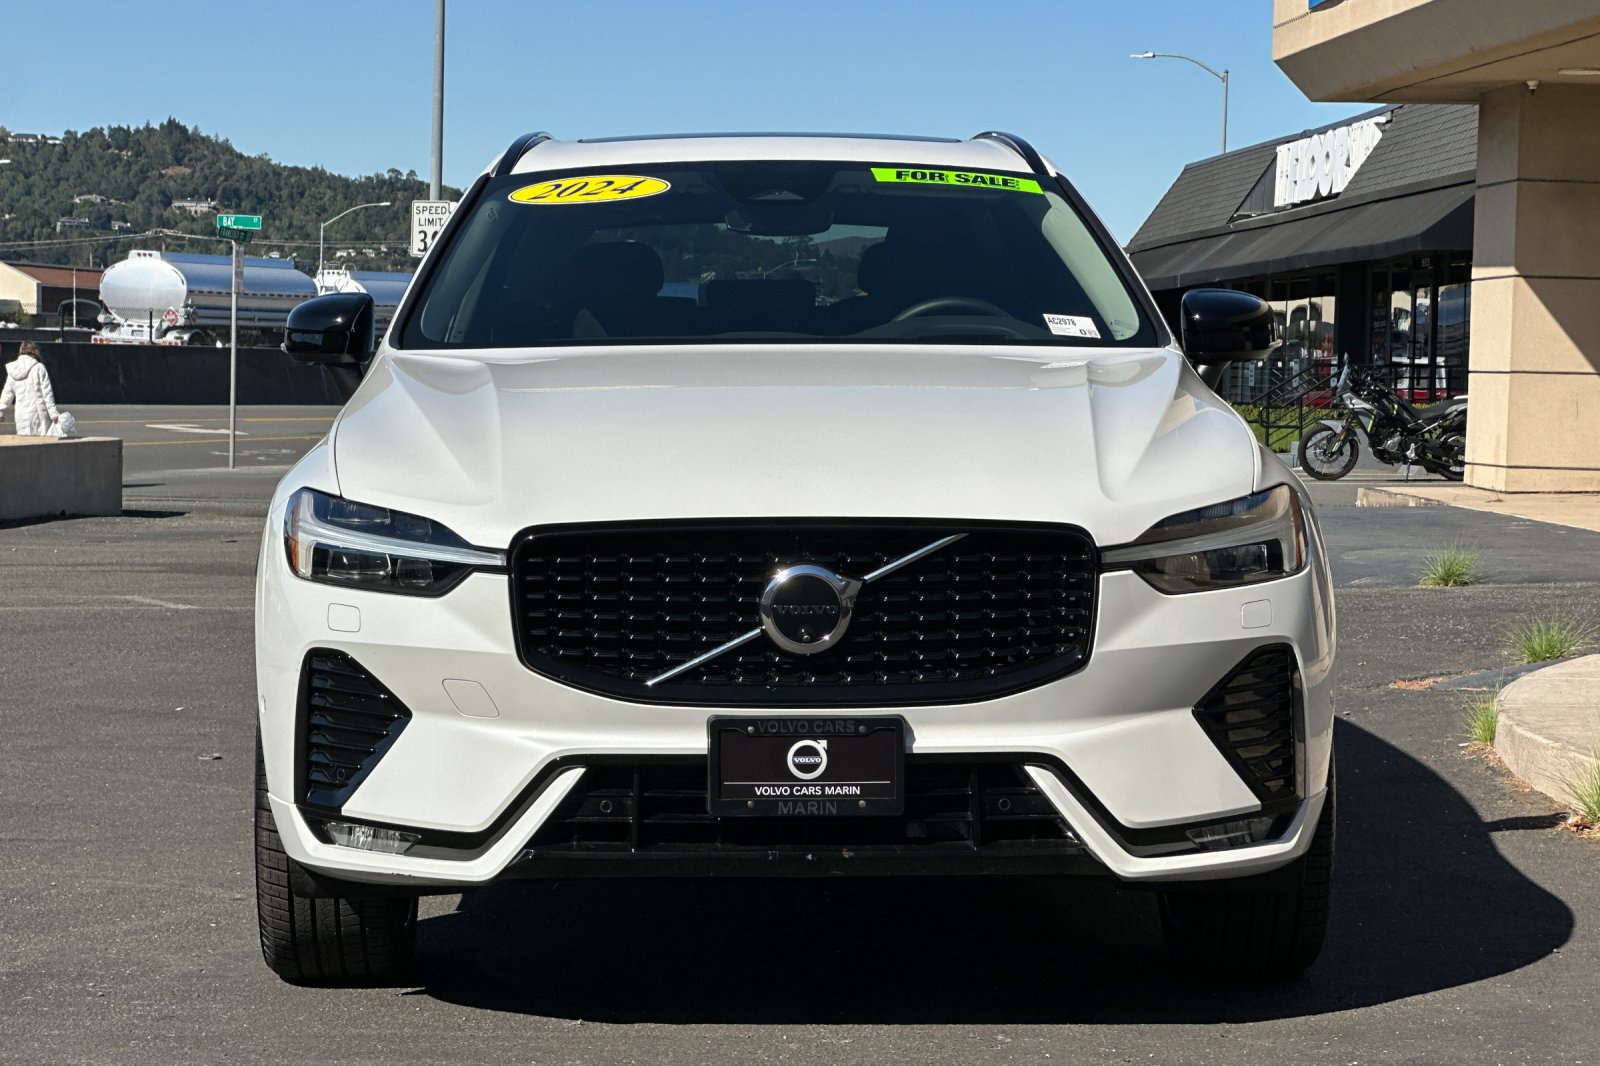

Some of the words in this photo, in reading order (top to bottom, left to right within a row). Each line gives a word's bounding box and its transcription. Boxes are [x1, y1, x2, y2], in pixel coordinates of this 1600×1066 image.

[896, 170, 950, 183] FOR
[954, 173, 1020, 189] SALE
[528, 180, 647, 200] 2024
[415, 205, 448, 215] SPEED
[222, 216, 236, 227] BAY
[418, 217, 444, 227] LIMIT
[417, 230, 439, 253] 3
[774, 604, 838, 615] VOLVO
[757, 721, 808, 733] VOLVO
[814, 720, 855, 733] CARS
[755, 786, 790, 796] VOLVO
[793, 786, 822, 795] CARS
[825, 786, 860, 795] MARIN
[778, 801, 837, 815] MARIN
